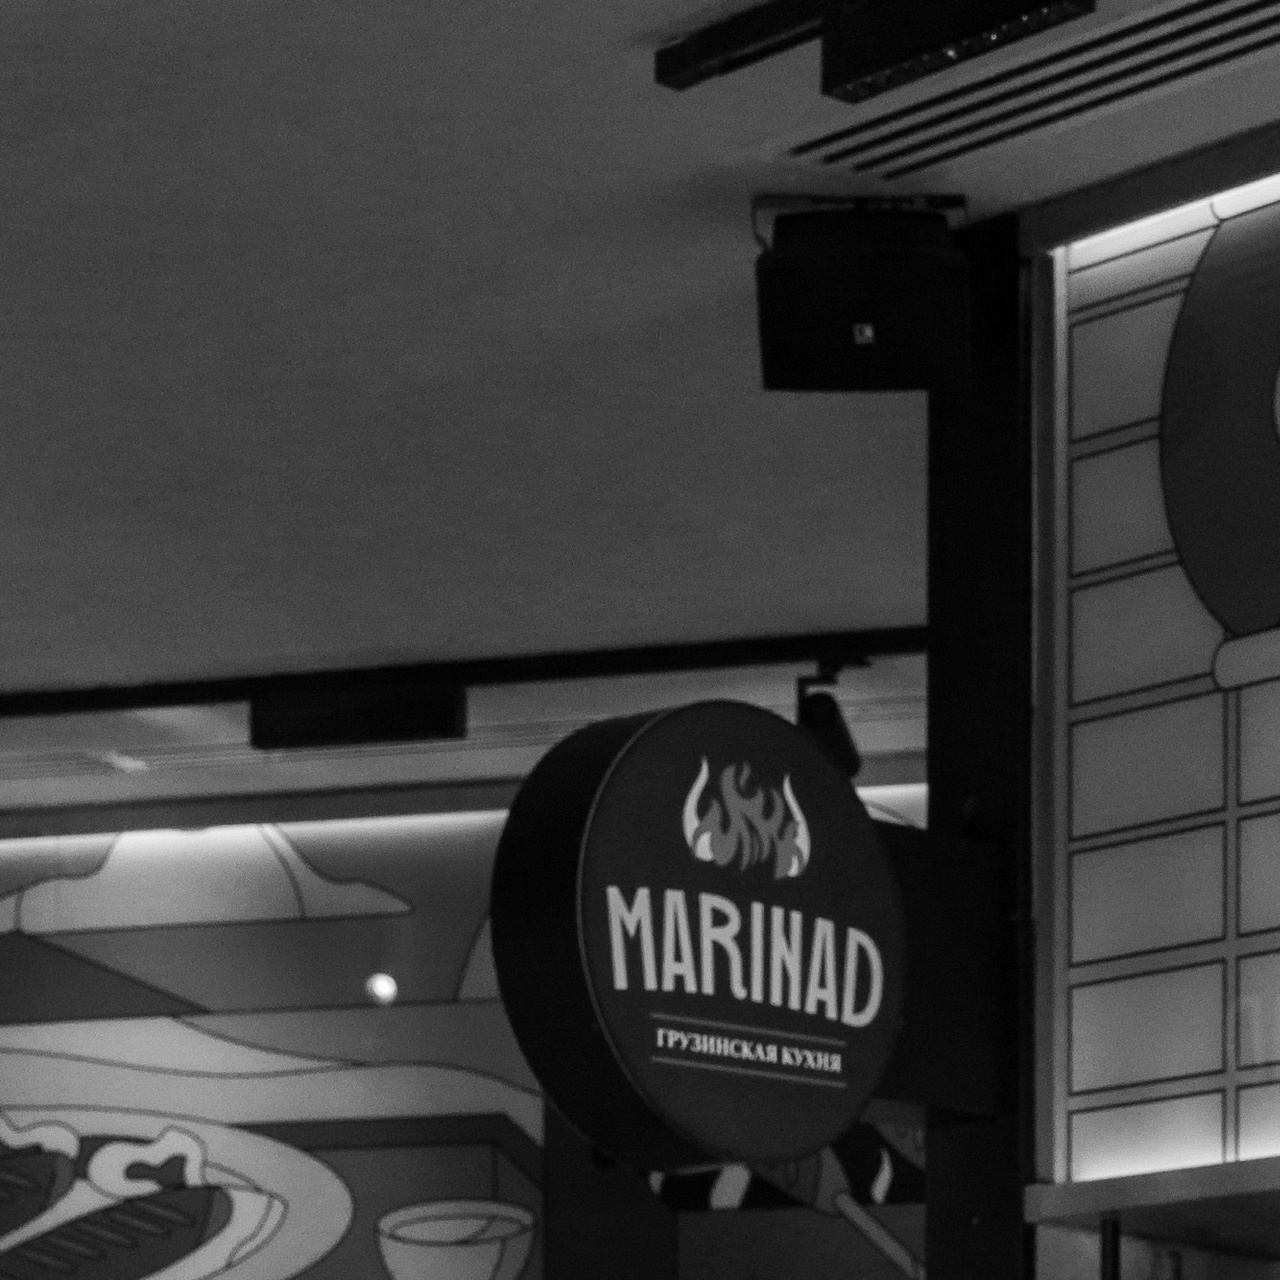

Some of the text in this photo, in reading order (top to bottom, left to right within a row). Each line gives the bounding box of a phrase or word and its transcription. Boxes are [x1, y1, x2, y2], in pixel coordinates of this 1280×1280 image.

[605, 884, 884, 1028] MARINAD
[656, 1027, 842, 1074] ГРУЗИНСКАЯ КУХНЯ
